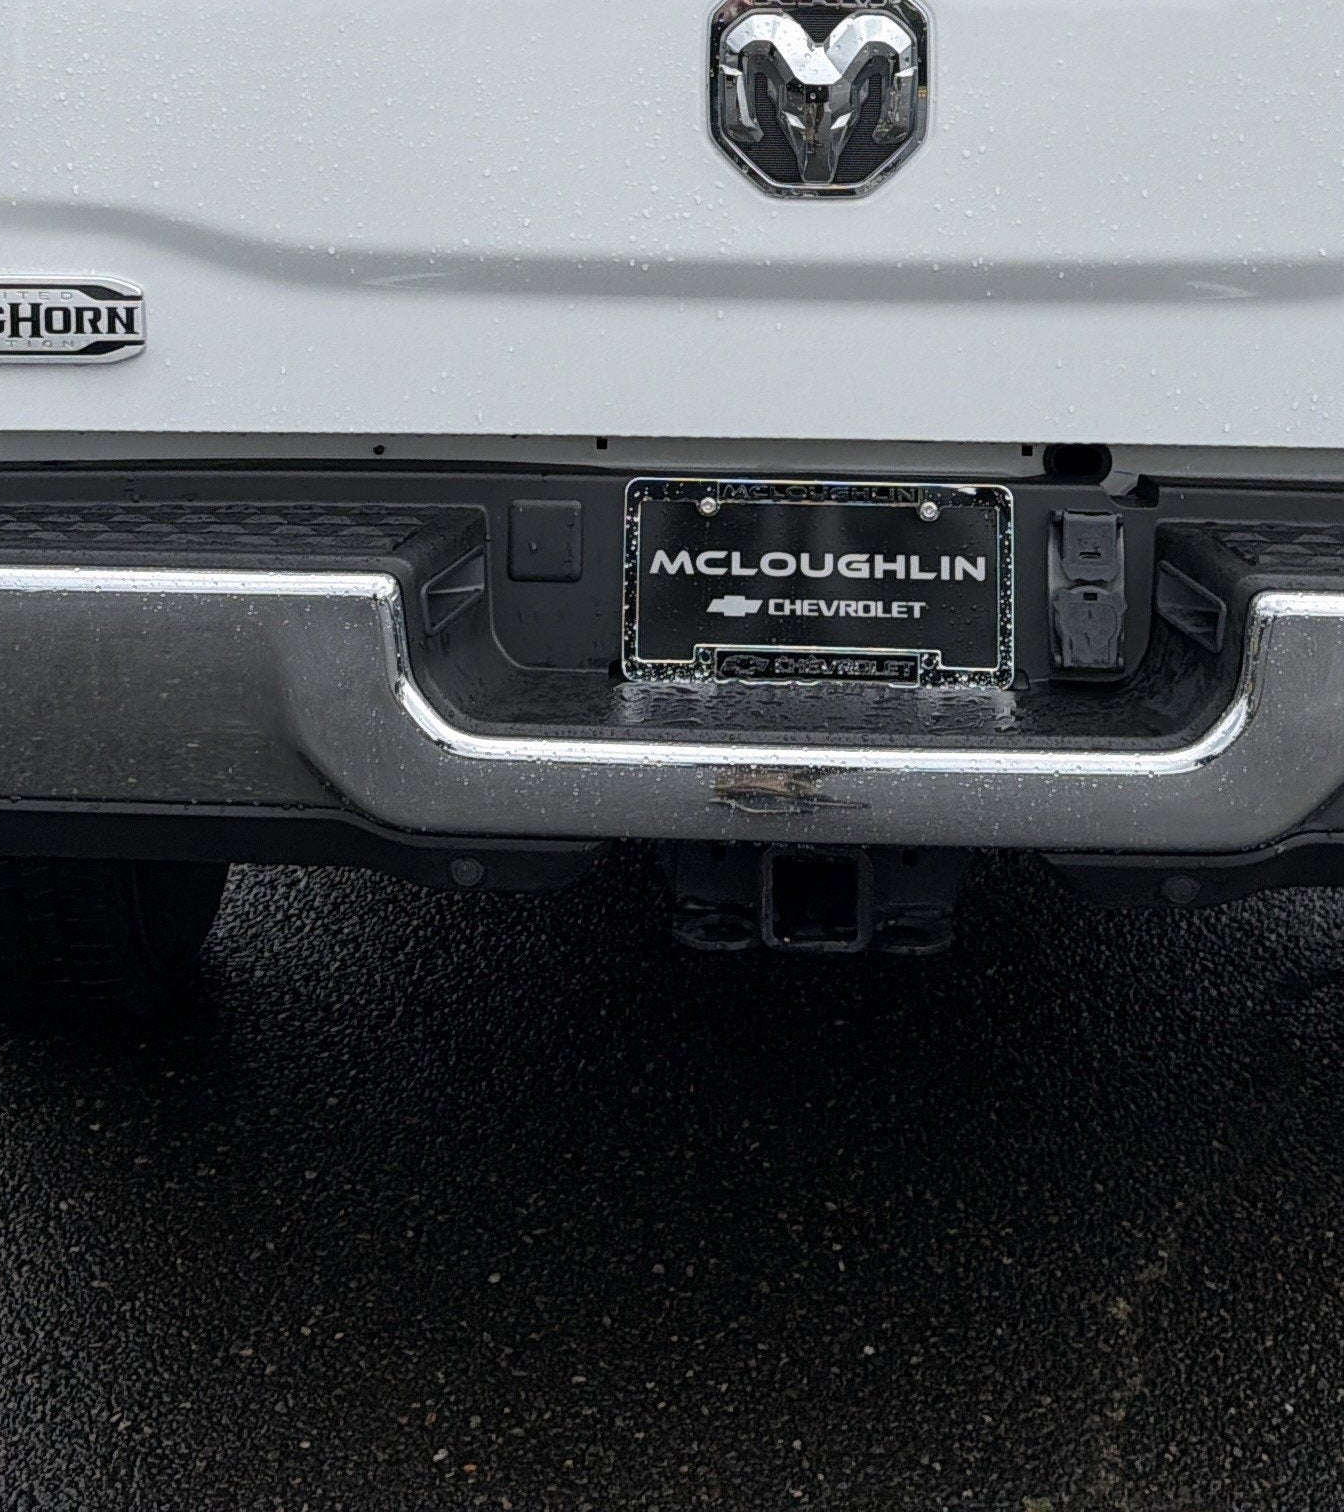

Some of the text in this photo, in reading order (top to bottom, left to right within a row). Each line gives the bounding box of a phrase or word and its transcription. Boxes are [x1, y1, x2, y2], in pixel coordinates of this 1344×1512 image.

[721, 483, 918, 502] MCLOUGHLIN
[649, 549, 987, 583] MCLOUGHLIN
[767, 597, 927, 620] CHEVROLET
[774, 657, 916, 677] CHEVROLET
